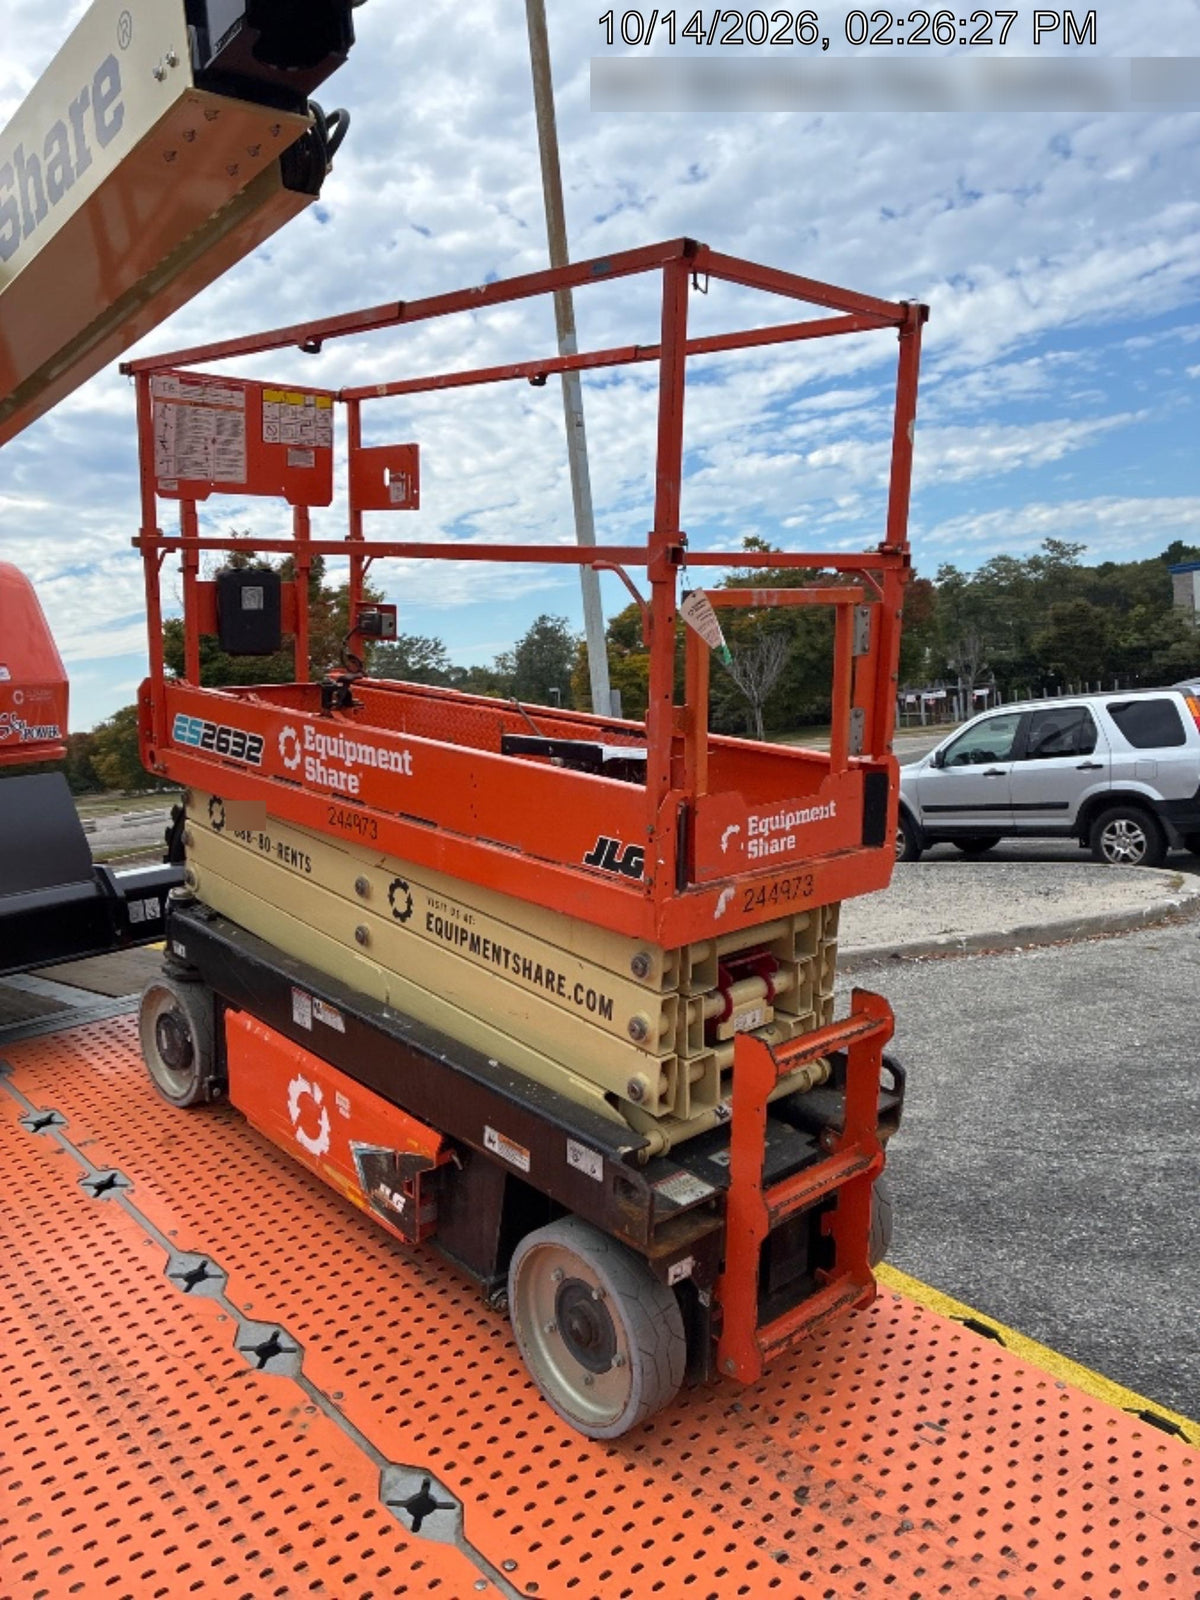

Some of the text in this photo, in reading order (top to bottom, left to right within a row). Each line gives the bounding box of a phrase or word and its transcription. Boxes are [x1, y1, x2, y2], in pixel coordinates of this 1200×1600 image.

[173, 713, 265, 767] ES2632
[303, 724, 413, 776] Equipment
[304, 755, 360, 794] Share
[327, 806, 378, 840] 244973
[747, 800, 837, 837] Equipment
[581, 834, 645, 882] JLG
[747, 834, 796, 860] Share
[742, 873, 814, 913] 244973
[425, 911, 614, 1021] EQUIPMENTSHARE.COM
